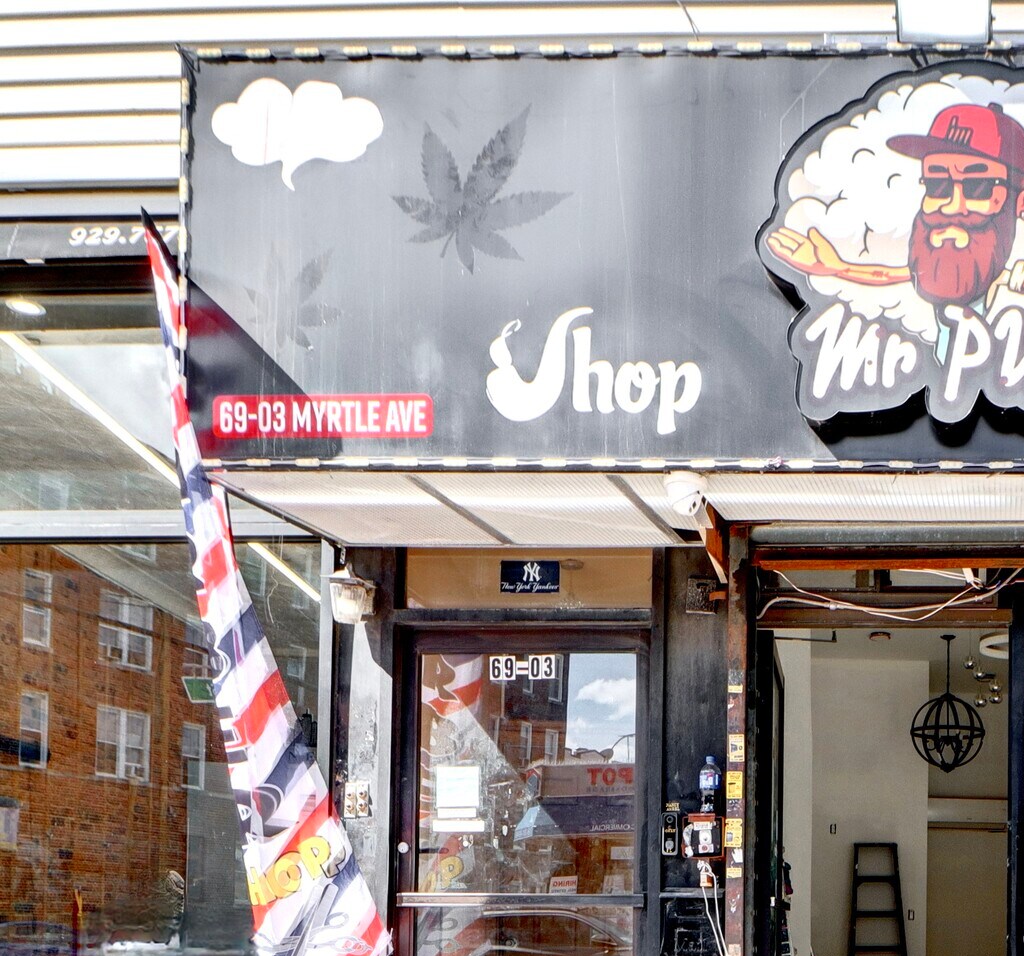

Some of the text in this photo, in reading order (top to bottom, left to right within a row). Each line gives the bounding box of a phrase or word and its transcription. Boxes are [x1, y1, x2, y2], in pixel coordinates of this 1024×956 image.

[806, 308, 917, 398] Mr
[219, 400, 427, 434] 69-03 MYRTLE AVE
[491, 656, 554, 680] 69-03
